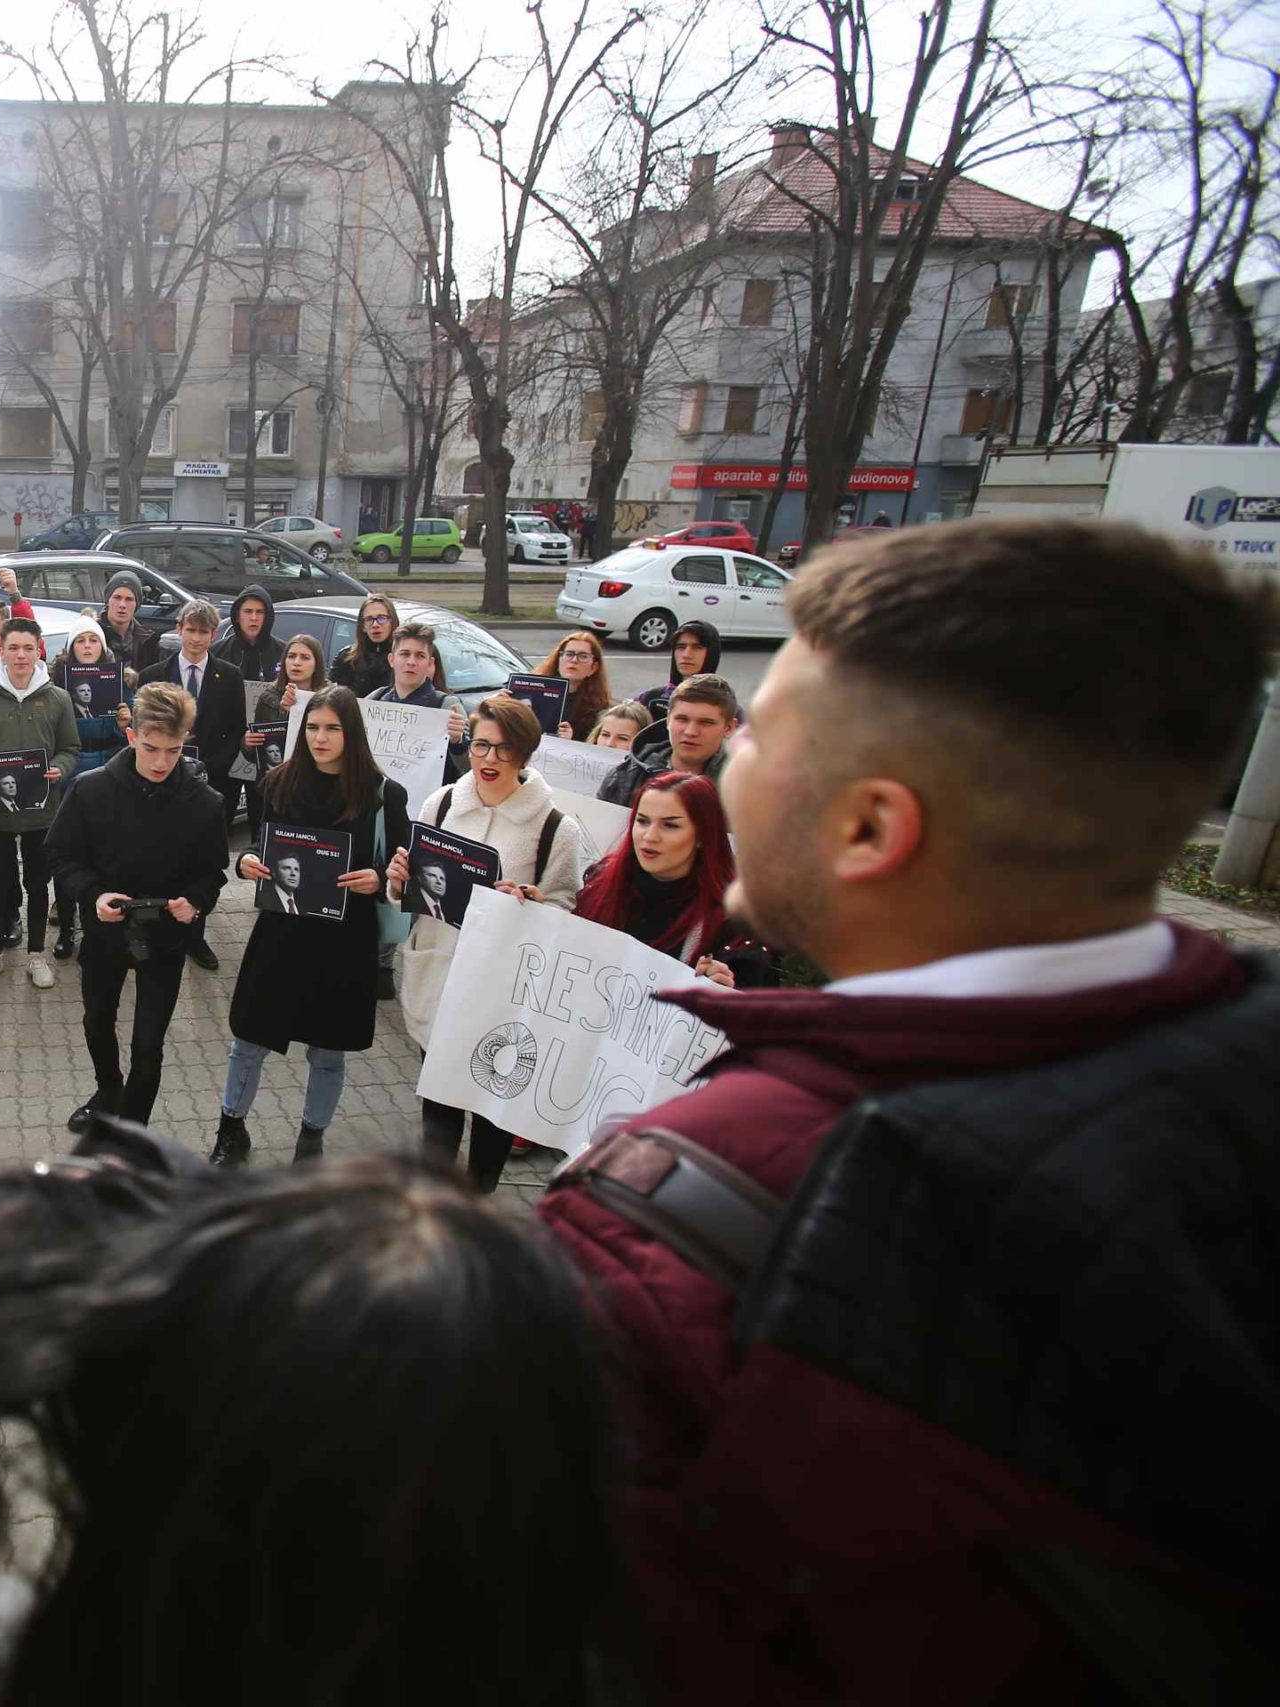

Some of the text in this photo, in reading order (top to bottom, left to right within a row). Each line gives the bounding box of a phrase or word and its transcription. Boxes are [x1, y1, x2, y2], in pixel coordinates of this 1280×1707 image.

[714, 470, 762, 483] aparate
[1234, 540, 1276, 553] TRUCK
[374, 728, 432, 759] MERGE
[275, 830, 318, 842] IULIAN IANCU,
[421, 835, 441, 847] IULIAN
[441, 843, 463, 856] IANCU,
[462, 864, 476, 873] OUG
